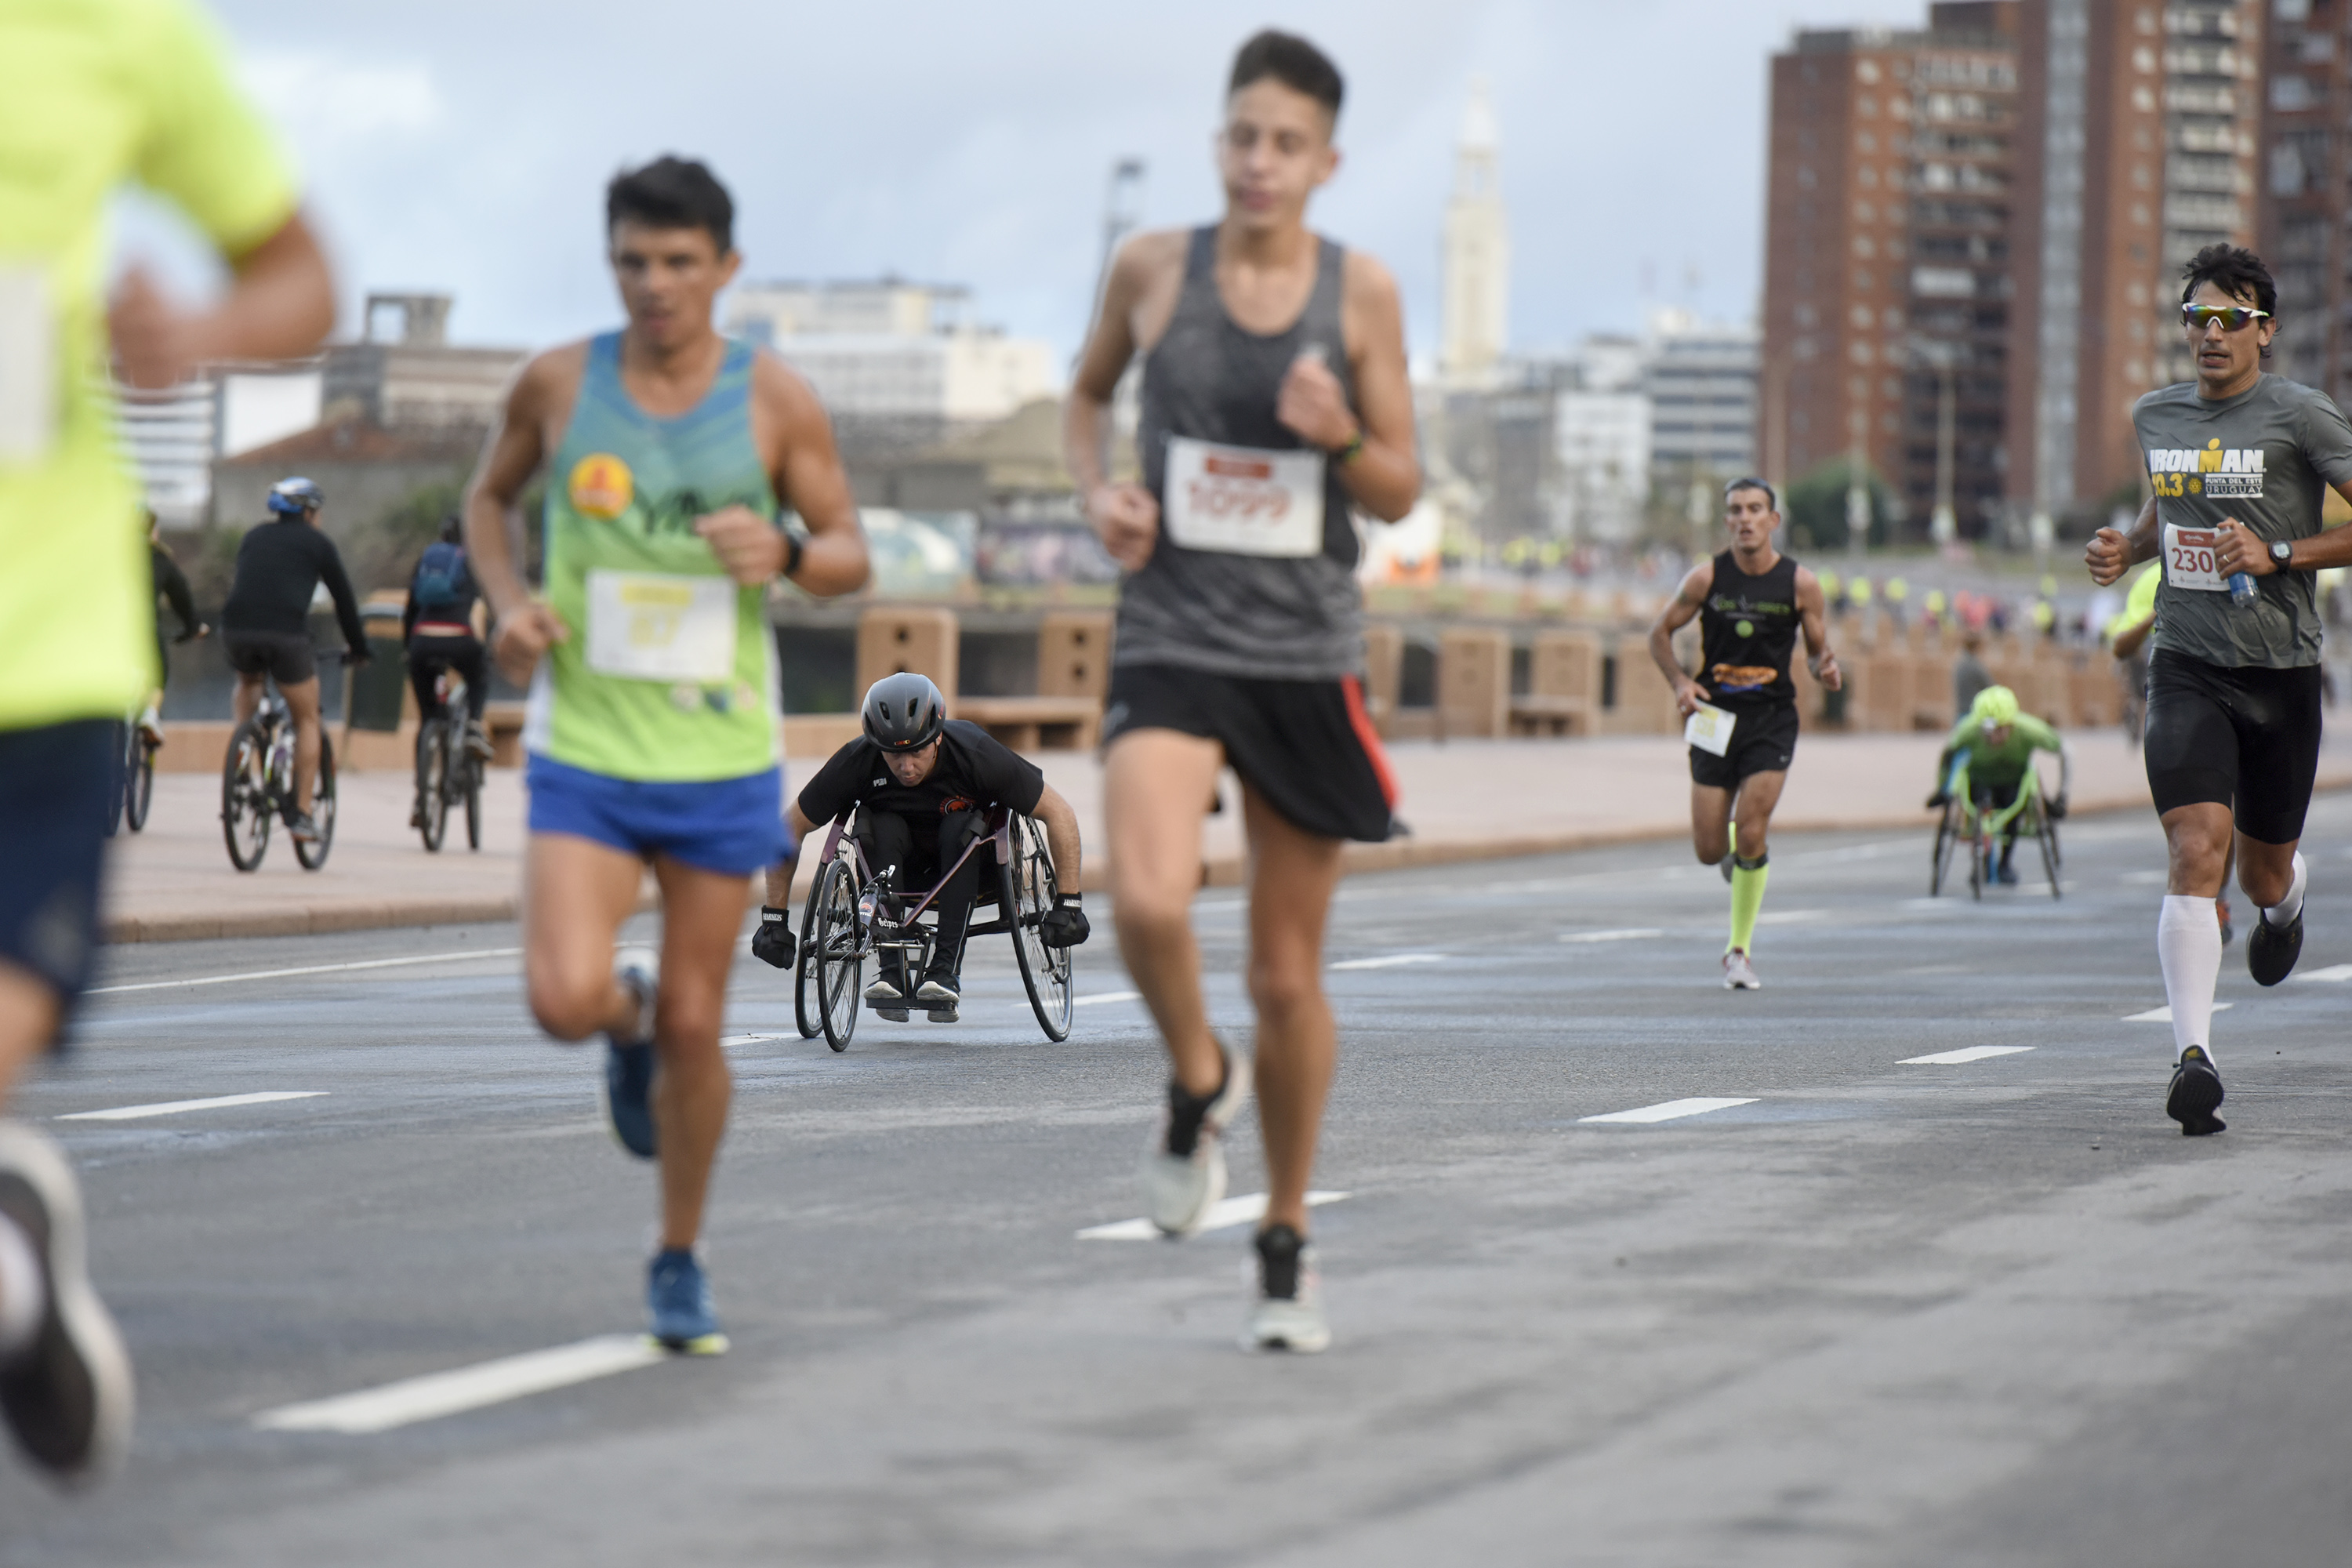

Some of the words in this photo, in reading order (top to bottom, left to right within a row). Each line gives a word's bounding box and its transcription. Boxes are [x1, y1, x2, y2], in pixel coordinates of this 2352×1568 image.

[2150, 448, 2264, 473] IRONMAN
[2205, 485, 2263, 494] URUGUAY
[2172, 547, 2214, 573] 230
